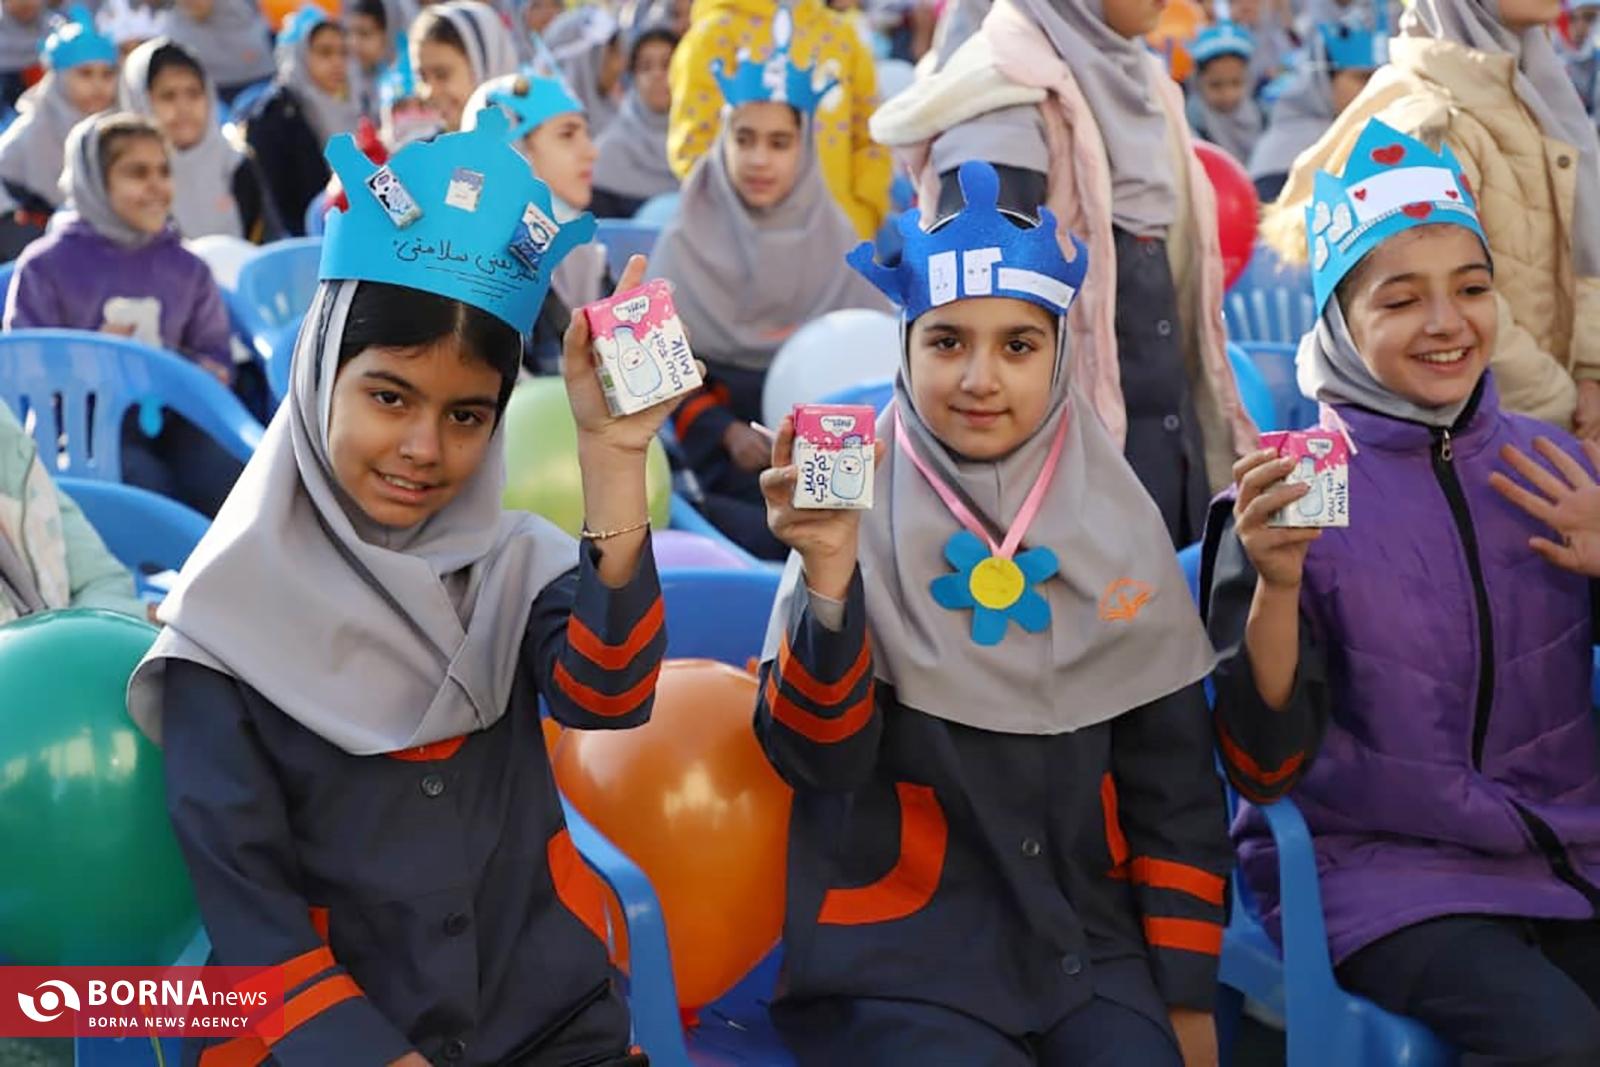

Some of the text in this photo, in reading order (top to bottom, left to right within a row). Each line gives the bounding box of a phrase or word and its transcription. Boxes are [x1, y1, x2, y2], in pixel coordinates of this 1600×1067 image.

[671, 335, 694, 376] Milk
[802, 461, 815, 496] شیر
[814, 453, 831, 471] کم
